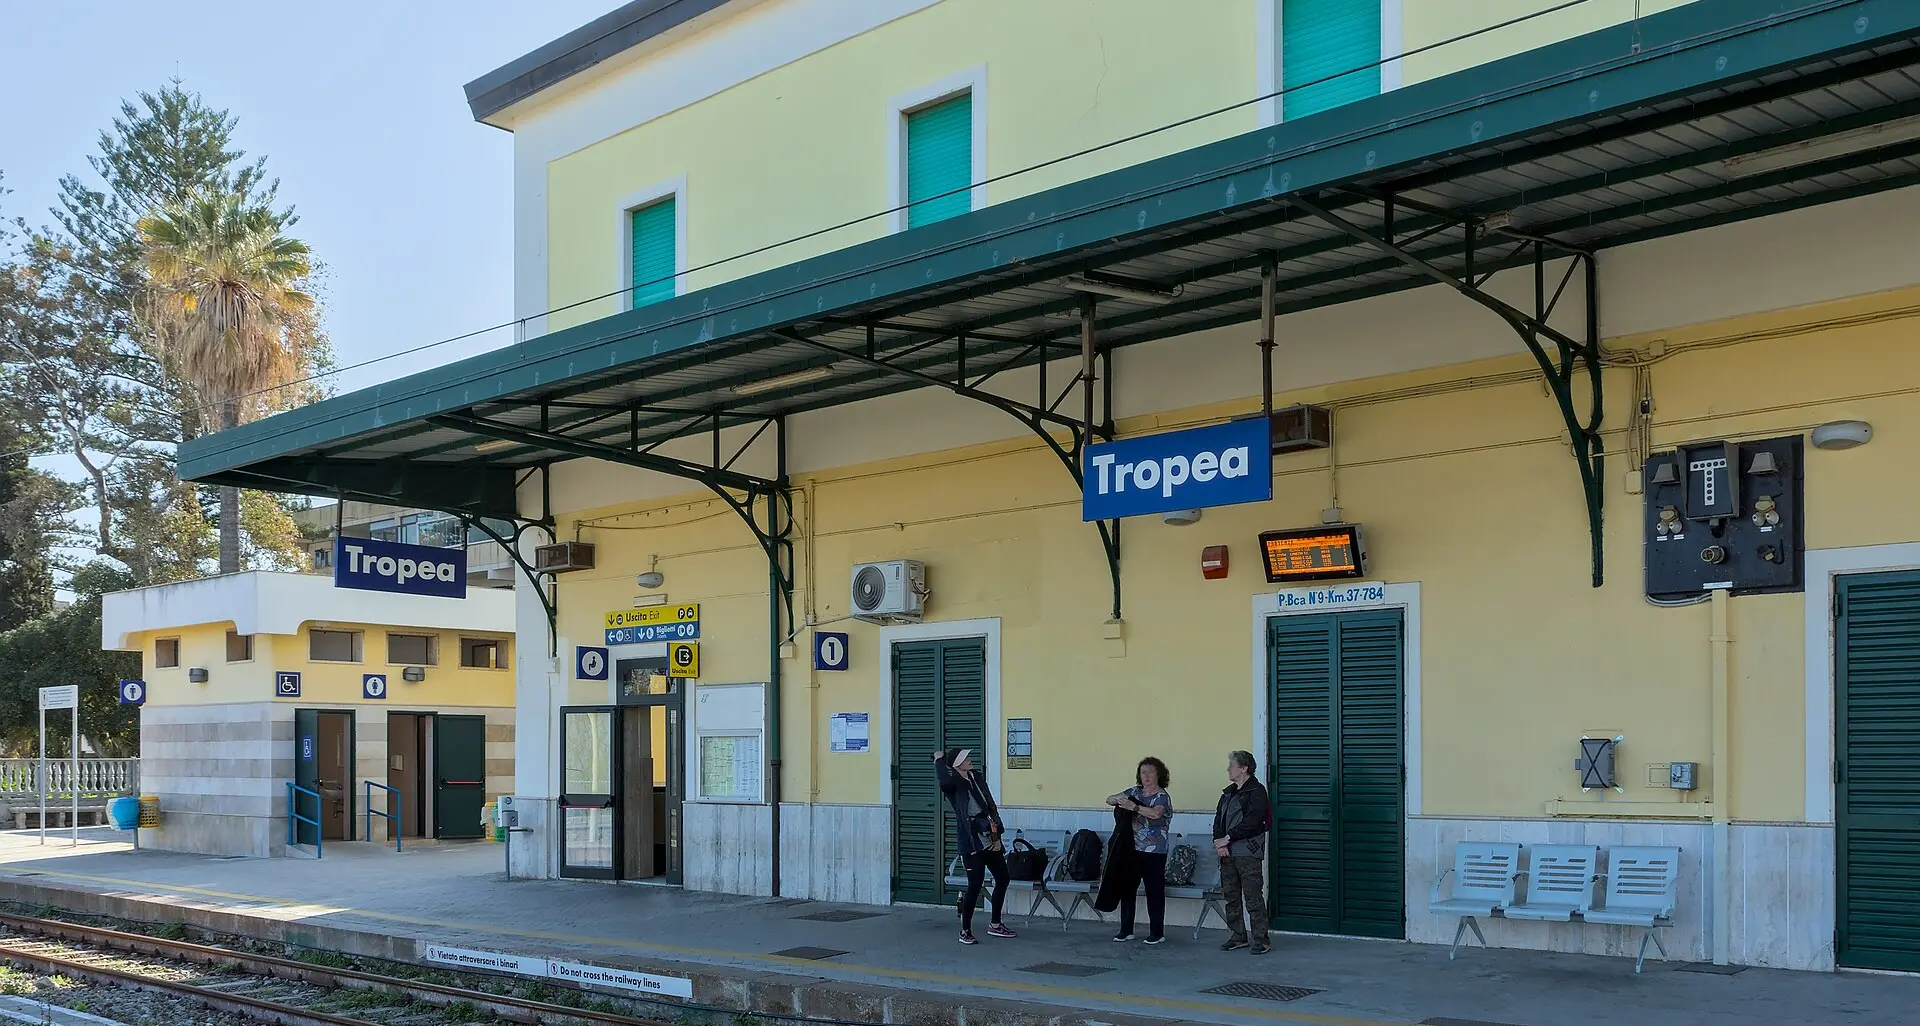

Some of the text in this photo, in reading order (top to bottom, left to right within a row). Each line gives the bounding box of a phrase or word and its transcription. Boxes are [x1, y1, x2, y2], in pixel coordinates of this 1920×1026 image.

[1092, 446, 1249, 498] Tropea
[345, 545, 456, 584] Tropea
[626, 612, 647, 622] Uscita
[650, 610, 660, 619] Exit
[828, 641, 835, 661] 1
[437, 950, 458, 961] Vietato
[459, 955, 496, 967] attraversare
[500, 959, 519, 969] binari
[560, 966, 661, 989] Do not cross the railway lines
